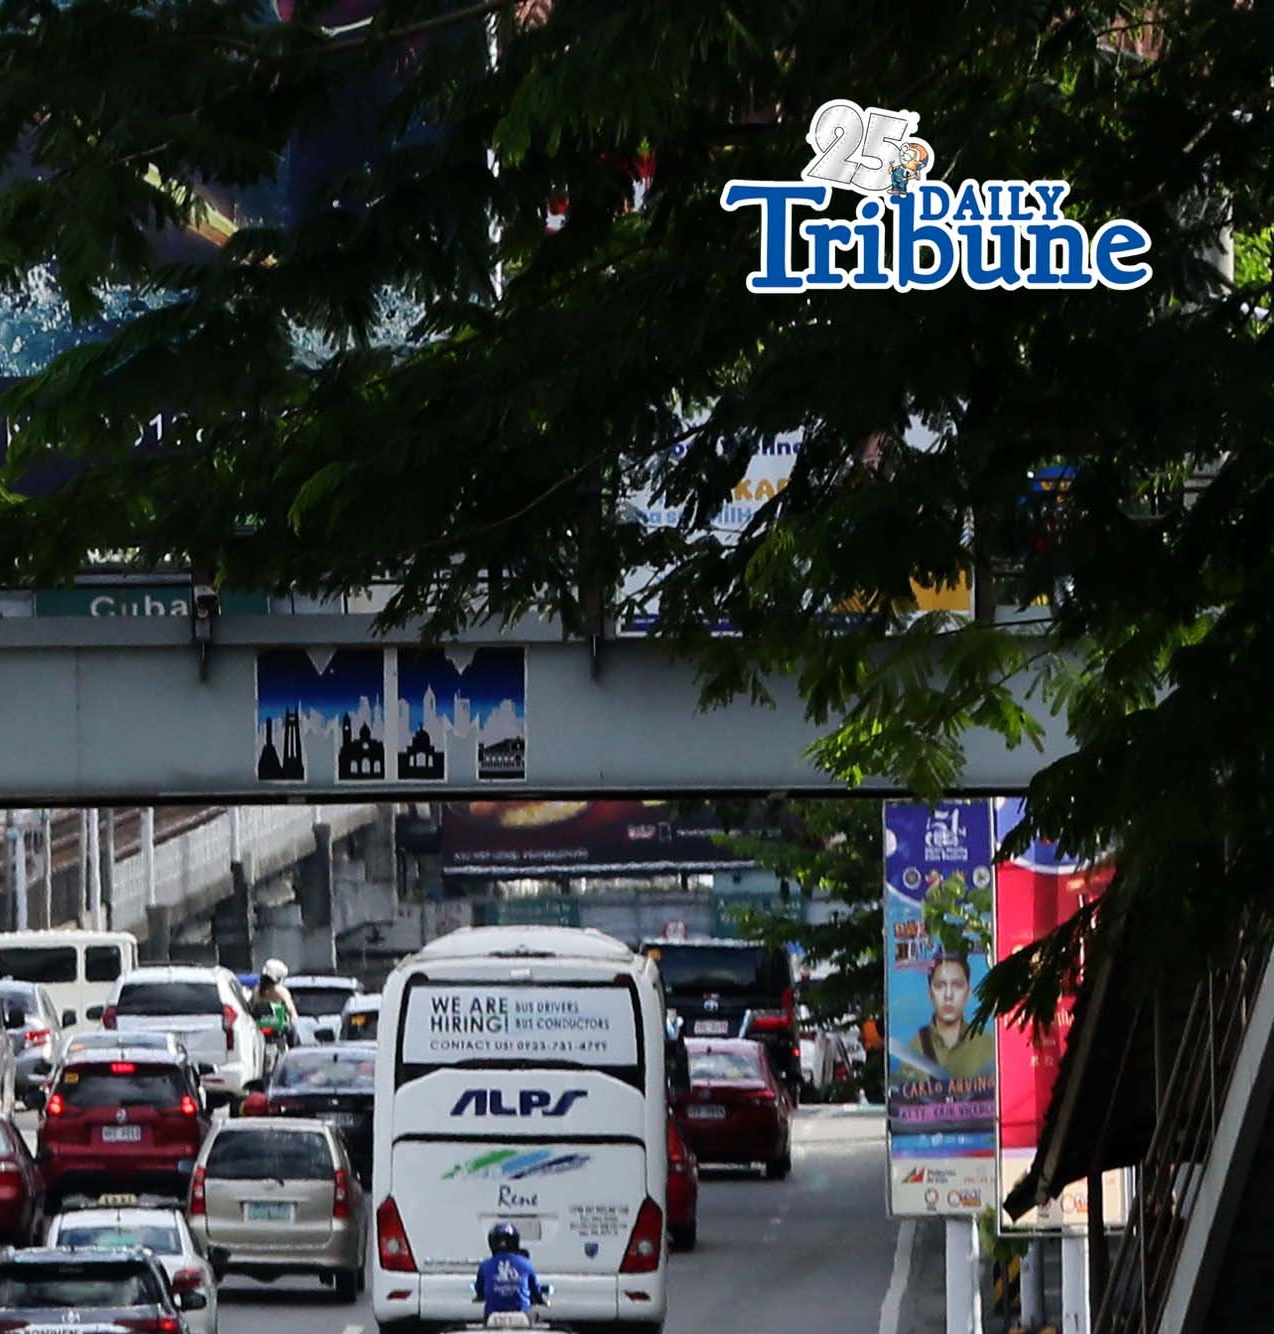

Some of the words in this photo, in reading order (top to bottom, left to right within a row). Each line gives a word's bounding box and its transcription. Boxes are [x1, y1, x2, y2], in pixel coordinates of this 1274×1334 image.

[89, 594, 191, 617] Cuba
[431, 996, 460, 1014] WE
[470, 996, 508, 1014] ARE
[515, 1002, 533, 1013] BUS
[537, 1002, 579, 1013] DRIVERS
[515, 1018, 533, 1030] BUS
[536, 1018, 610, 1031] CONDUCTORS
[429, 1040, 490, 1051] CONTACT
[450, 1088, 588, 1117] ALPS
